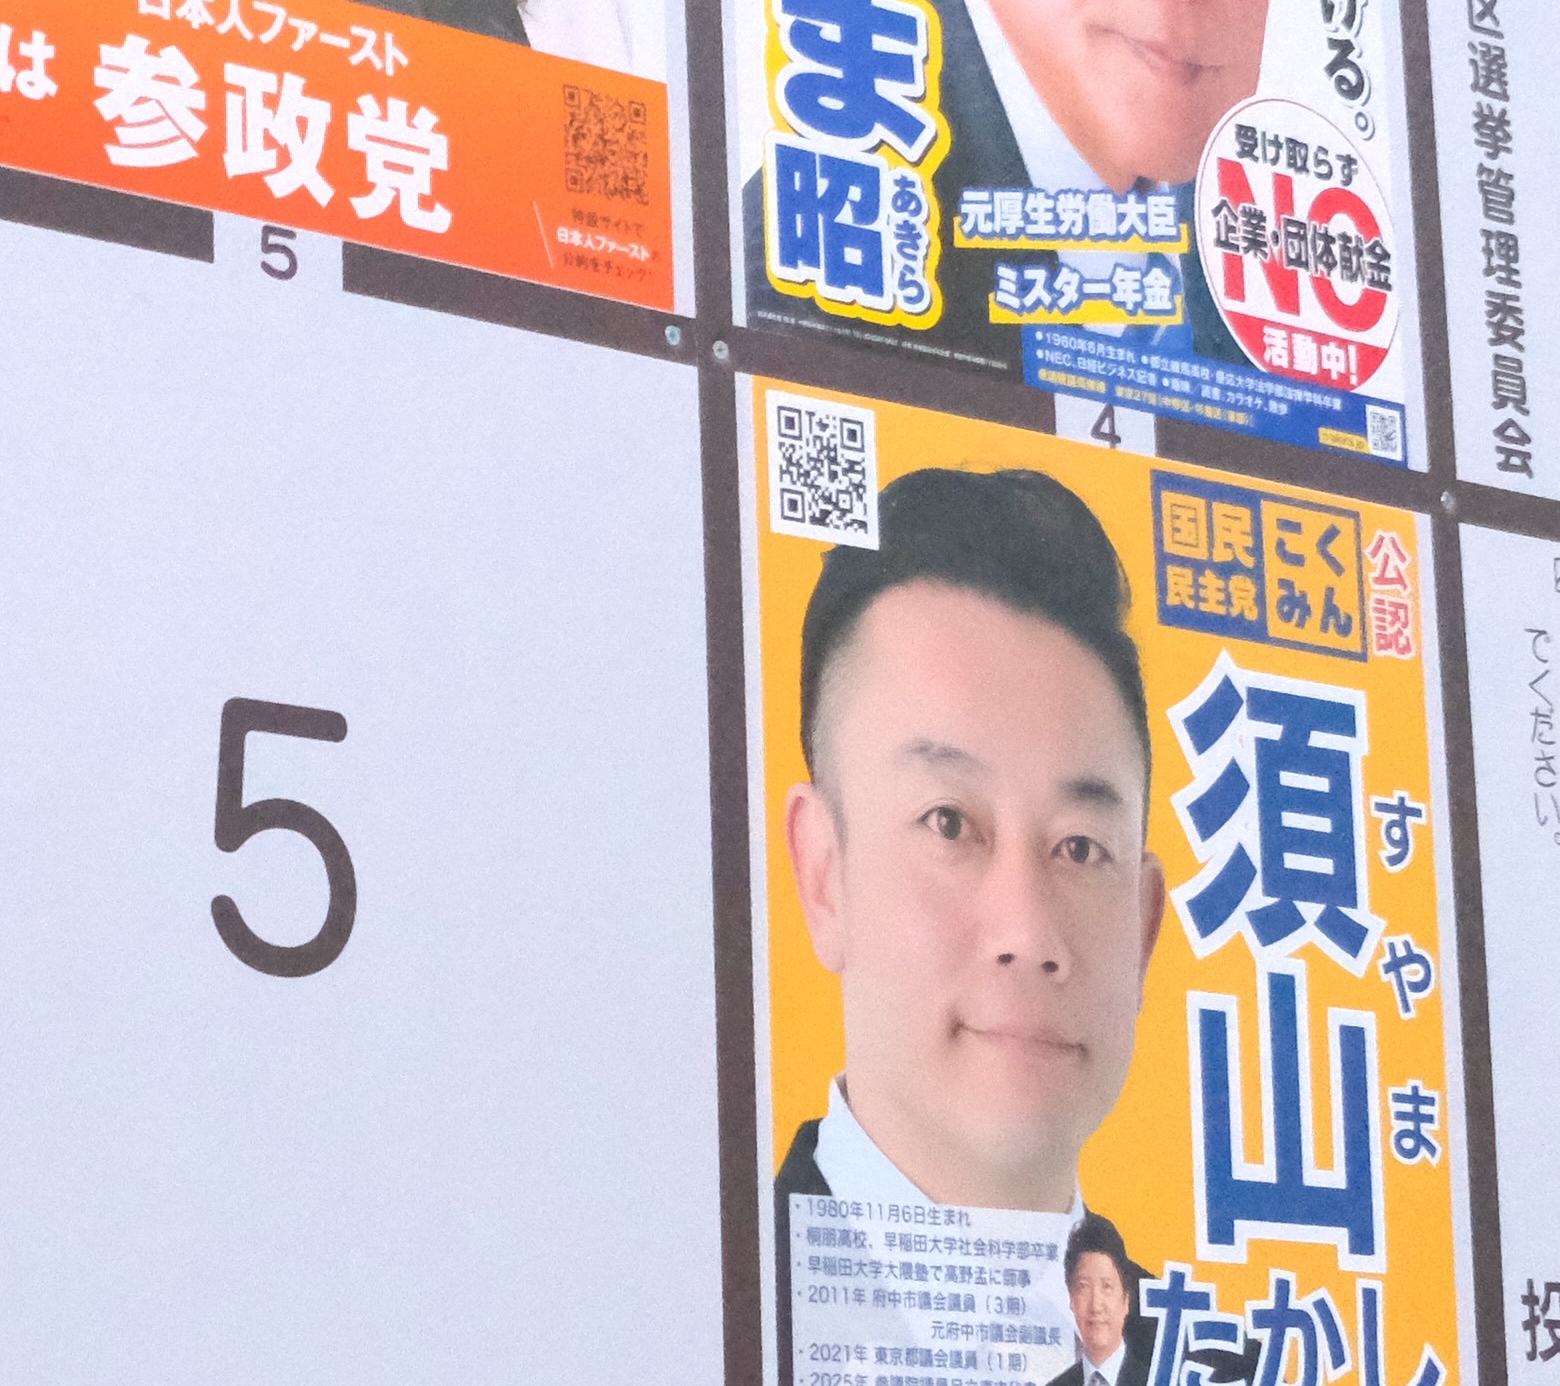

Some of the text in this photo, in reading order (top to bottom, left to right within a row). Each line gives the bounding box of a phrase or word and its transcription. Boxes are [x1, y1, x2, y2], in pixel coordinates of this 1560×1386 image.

[93, 34, 453, 235] 参政党
[1234, 123, 1360, 186] 受け取らず
[260, 225, 299, 281] 5
[891, 174, 930, 311] あきら
[960, 189, 1178, 239] 元厚生労働大臣
[1211, 198, 1393, 294] 企業・団体献金
[994, 265, 1175, 313] ミスター年金
[1090, 404, 1123, 449] 4
[1161, 490, 1256, 569] 国民
[1166, 564, 1260, 621] 民主党
[1367, 533, 1413, 657] 公認
[210, 695, 358, 979] 5
[1185, 672, 1378, 1258] 須山
